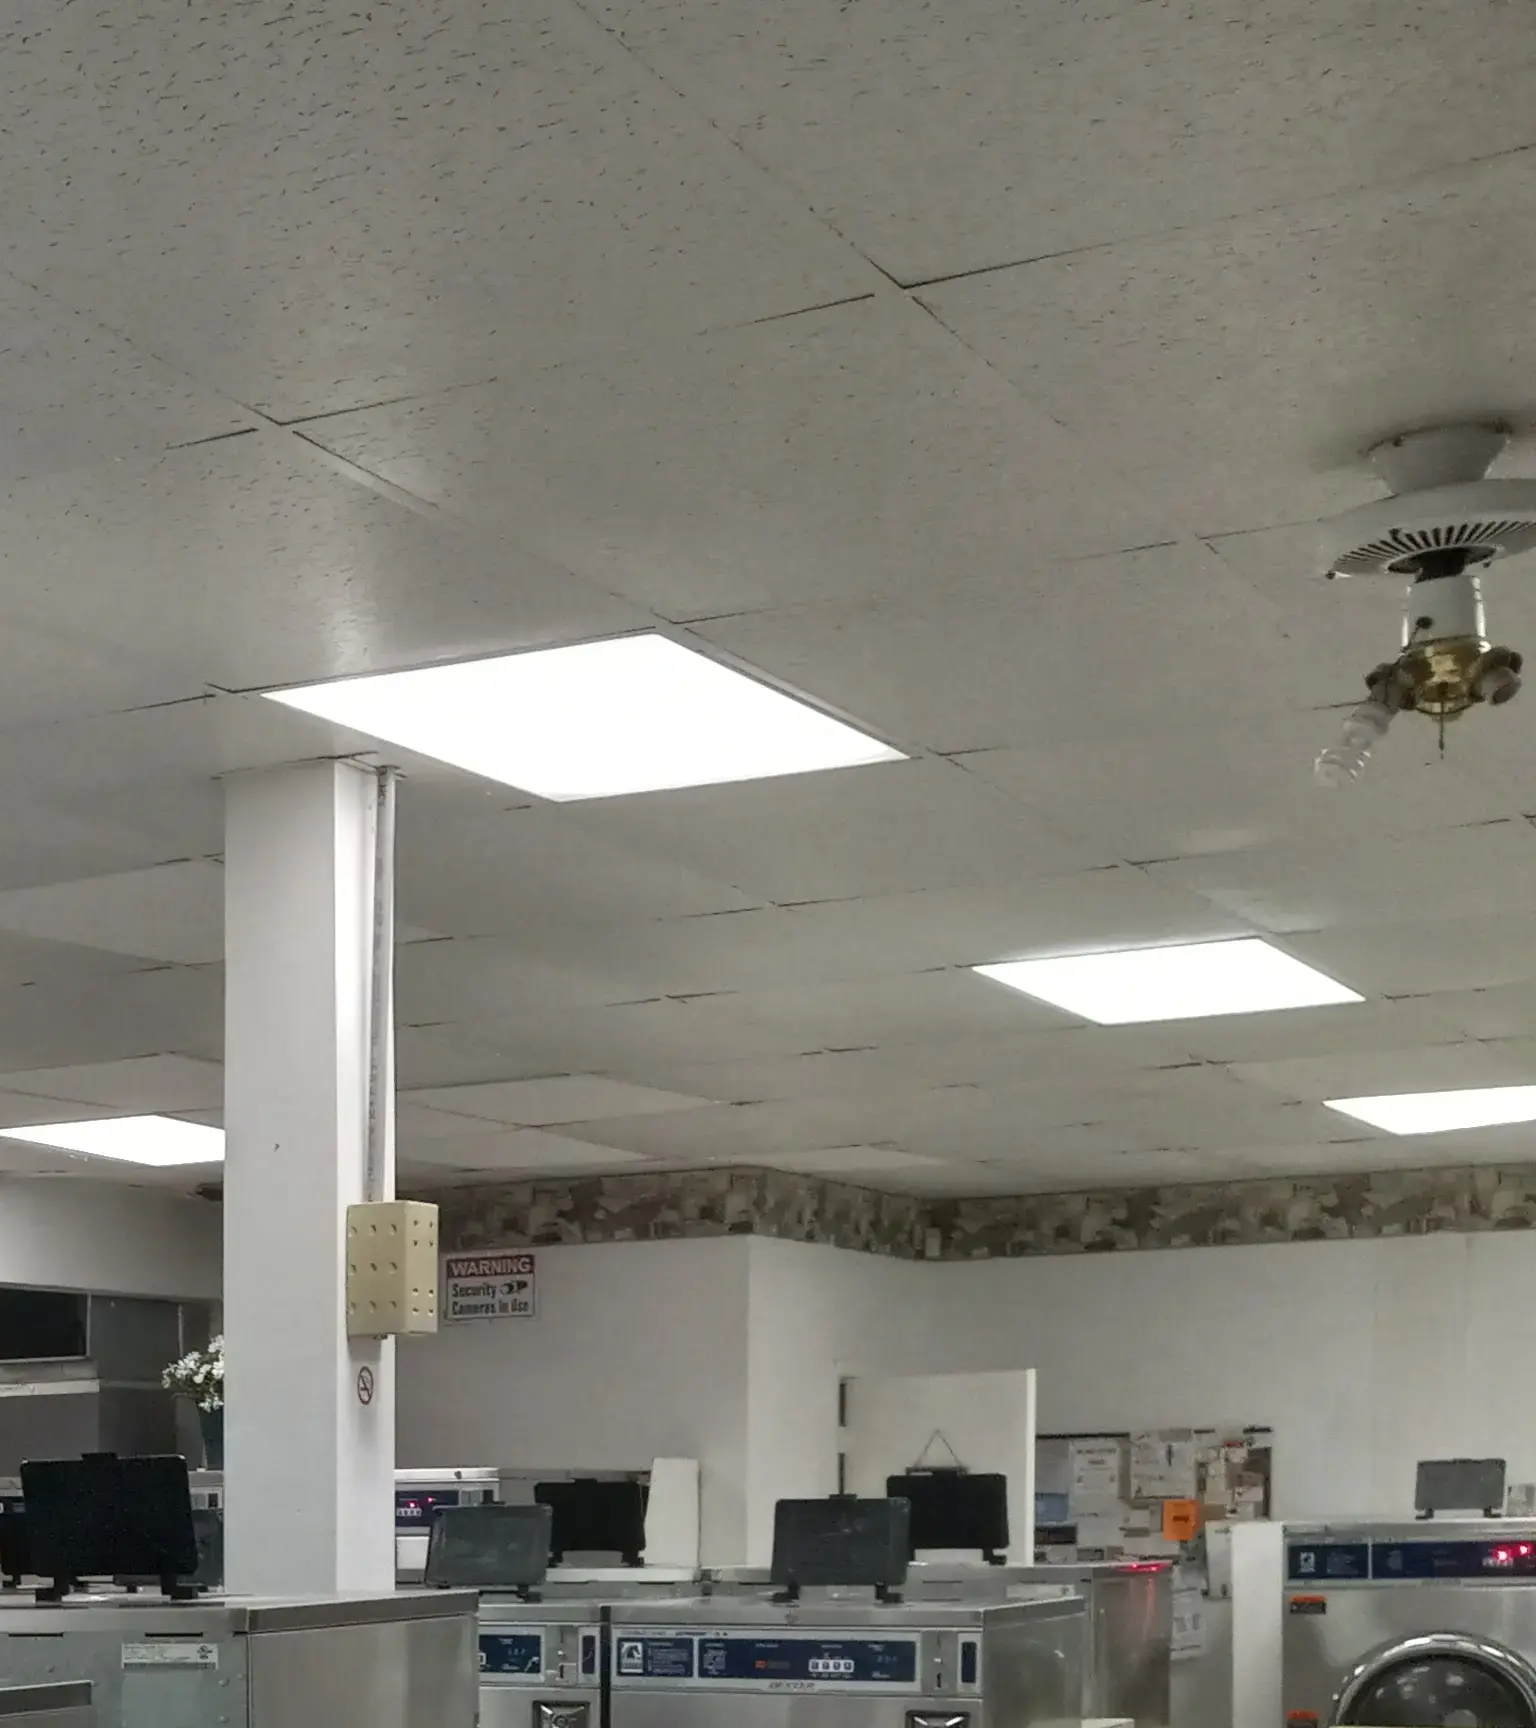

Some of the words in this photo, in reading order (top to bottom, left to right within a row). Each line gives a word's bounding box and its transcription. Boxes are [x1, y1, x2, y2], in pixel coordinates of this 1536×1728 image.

[450, 1257, 530, 1277] WARNING
[451, 1282, 496, 1299] Security
[451, 1300, 496, 1315] Cameras
